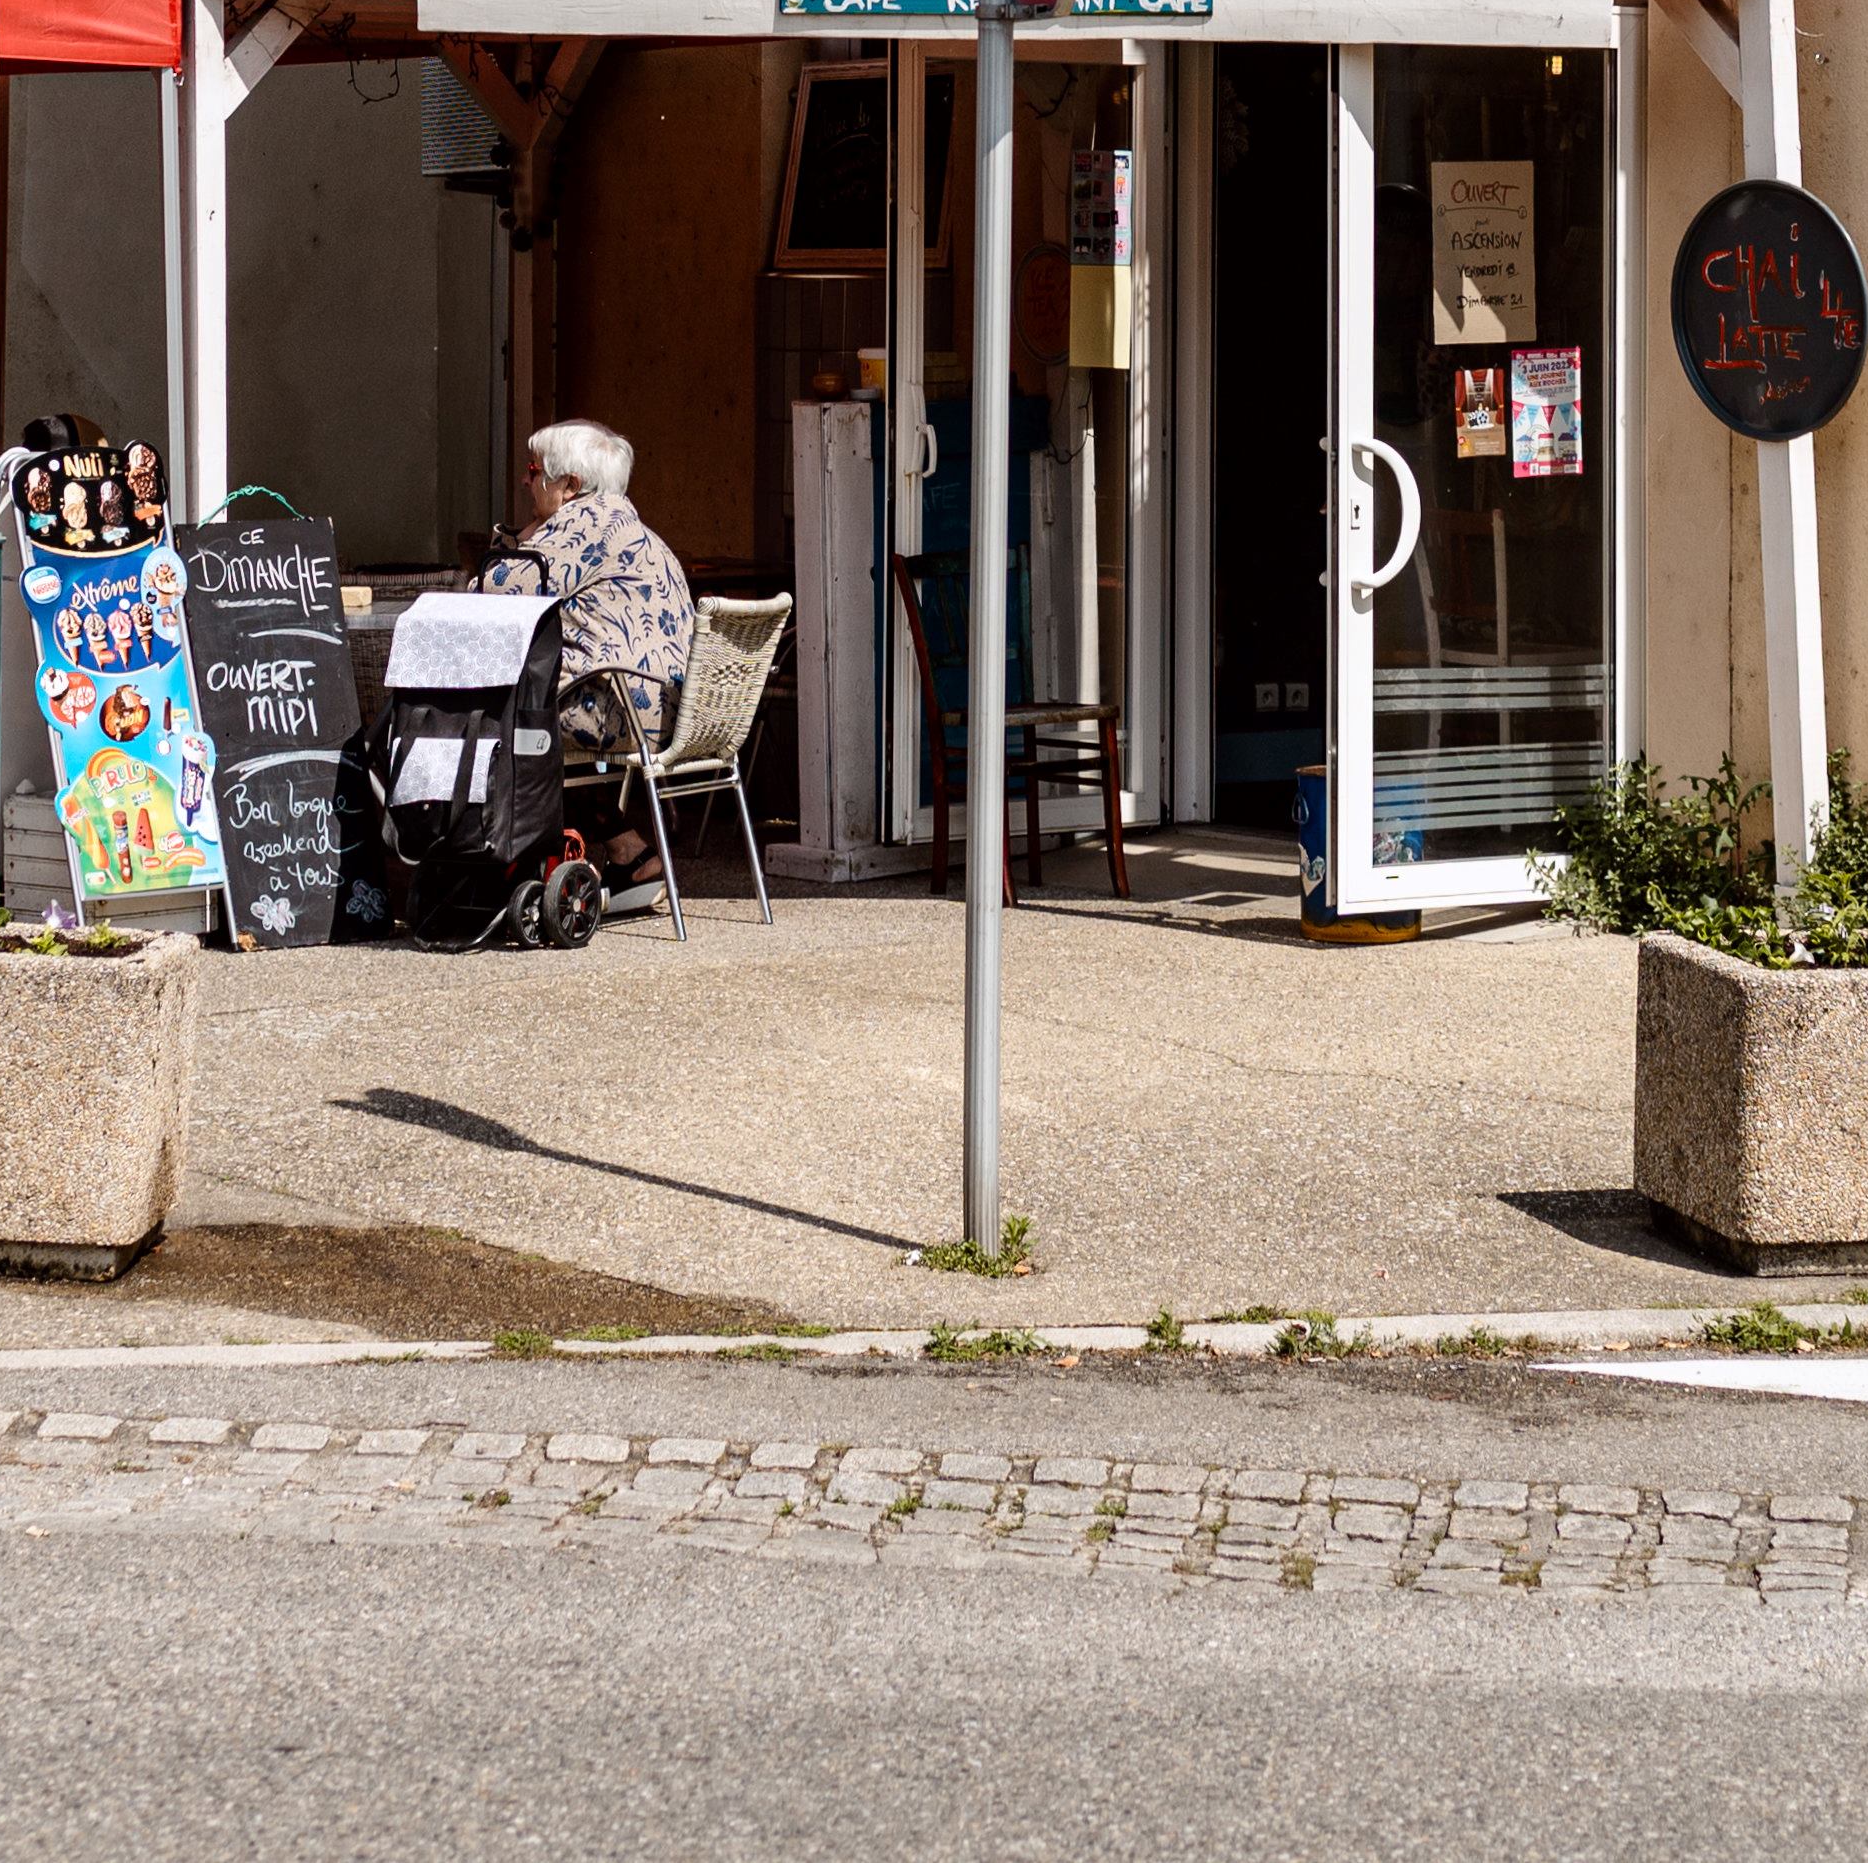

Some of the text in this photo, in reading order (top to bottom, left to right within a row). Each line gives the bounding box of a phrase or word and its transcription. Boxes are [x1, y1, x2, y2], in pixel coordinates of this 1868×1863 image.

[1451, 179, 1520, 205] OUVERT
[1529, 362, 1550, 373] JUIN
[239, 528, 265, 545] CE
[223, 783, 280, 828] Bon
[244, 833, 365, 864] weekend
[269, 866, 290, 891] à
